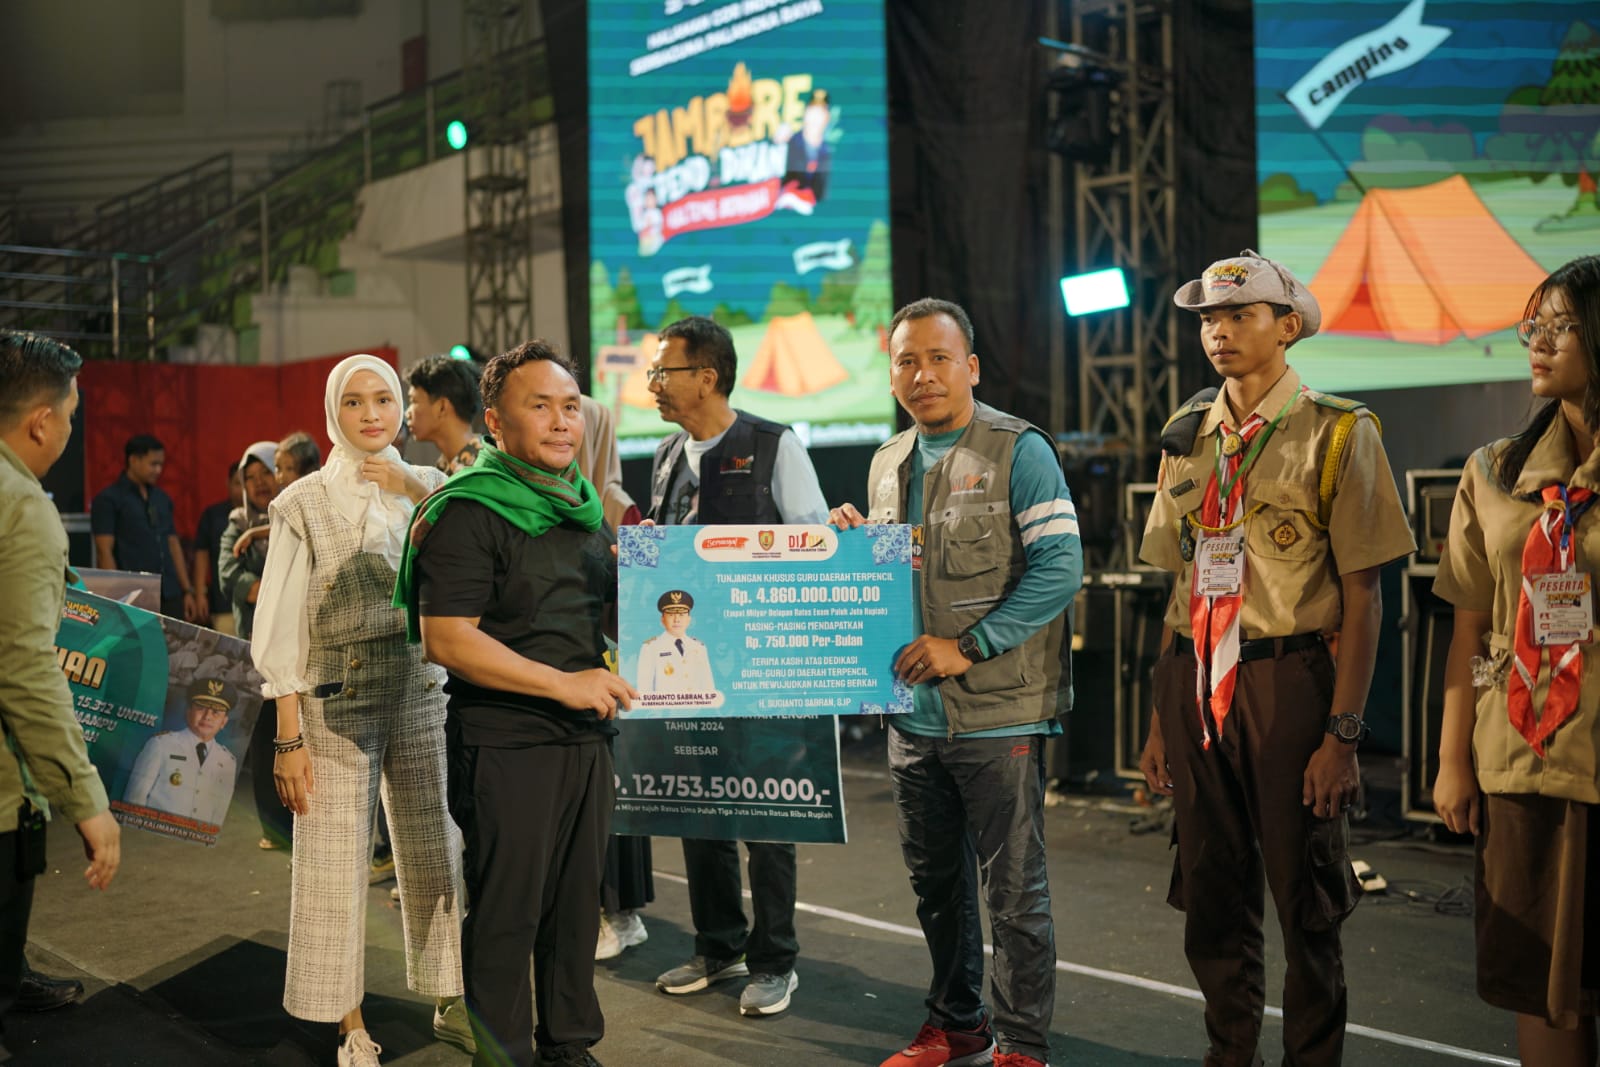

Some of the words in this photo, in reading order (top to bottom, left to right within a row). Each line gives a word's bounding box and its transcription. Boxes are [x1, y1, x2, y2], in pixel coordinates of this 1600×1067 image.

[715, 574, 763, 583] TUNJANGAN
[764, 573, 796, 583] KHUSUS
[796, 573, 819, 582] GURU
[819, 572, 850, 582] DAERAH
[852, 572, 894, 581] TERPENCIL
[1539, 580, 1584, 592] PESERTA
[730, 587, 753, 607] Rp.
[756, 586, 881, 605] 4.860.000.000,00
[744, 621, 807, 631] MASING-MASING
[807, 620, 864, 630] MENDAPATKAN
[745, 636, 762, 650] Rp.
[765, 636, 809, 648] 750.000
[812, 635, 863, 647] Per-Bulan
[752, 657, 780, 666] TERIMA
[781, 656, 804, 665] KASIH
[804, 656, 823, 665] ATAS
[823, 656, 858, 665] DEDIKASI
[741, 669, 787, 678] GURU-GURU
[787, 668, 796, 678] DI
[796, 668, 827, 677] DAERAH
[828, 667, 869, 677] TERPENCIL
[732, 681, 758, 690] UNTUK
[759, 680, 812, 689] MEWUJUDKAN
[813, 679, 846, 688] KALTENG
[846, 679, 878, 688] BERKAH
[766, 699, 804, 708] SUGIANTO
[116, 705, 159, 727] UNTUK
[664, 721, 698, 731] TAHUN
[700, 721, 724, 732] 2024
[673, 745, 719, 756] SEBESAR
[632, 774, 831, 806] 12.753.500.000,-
